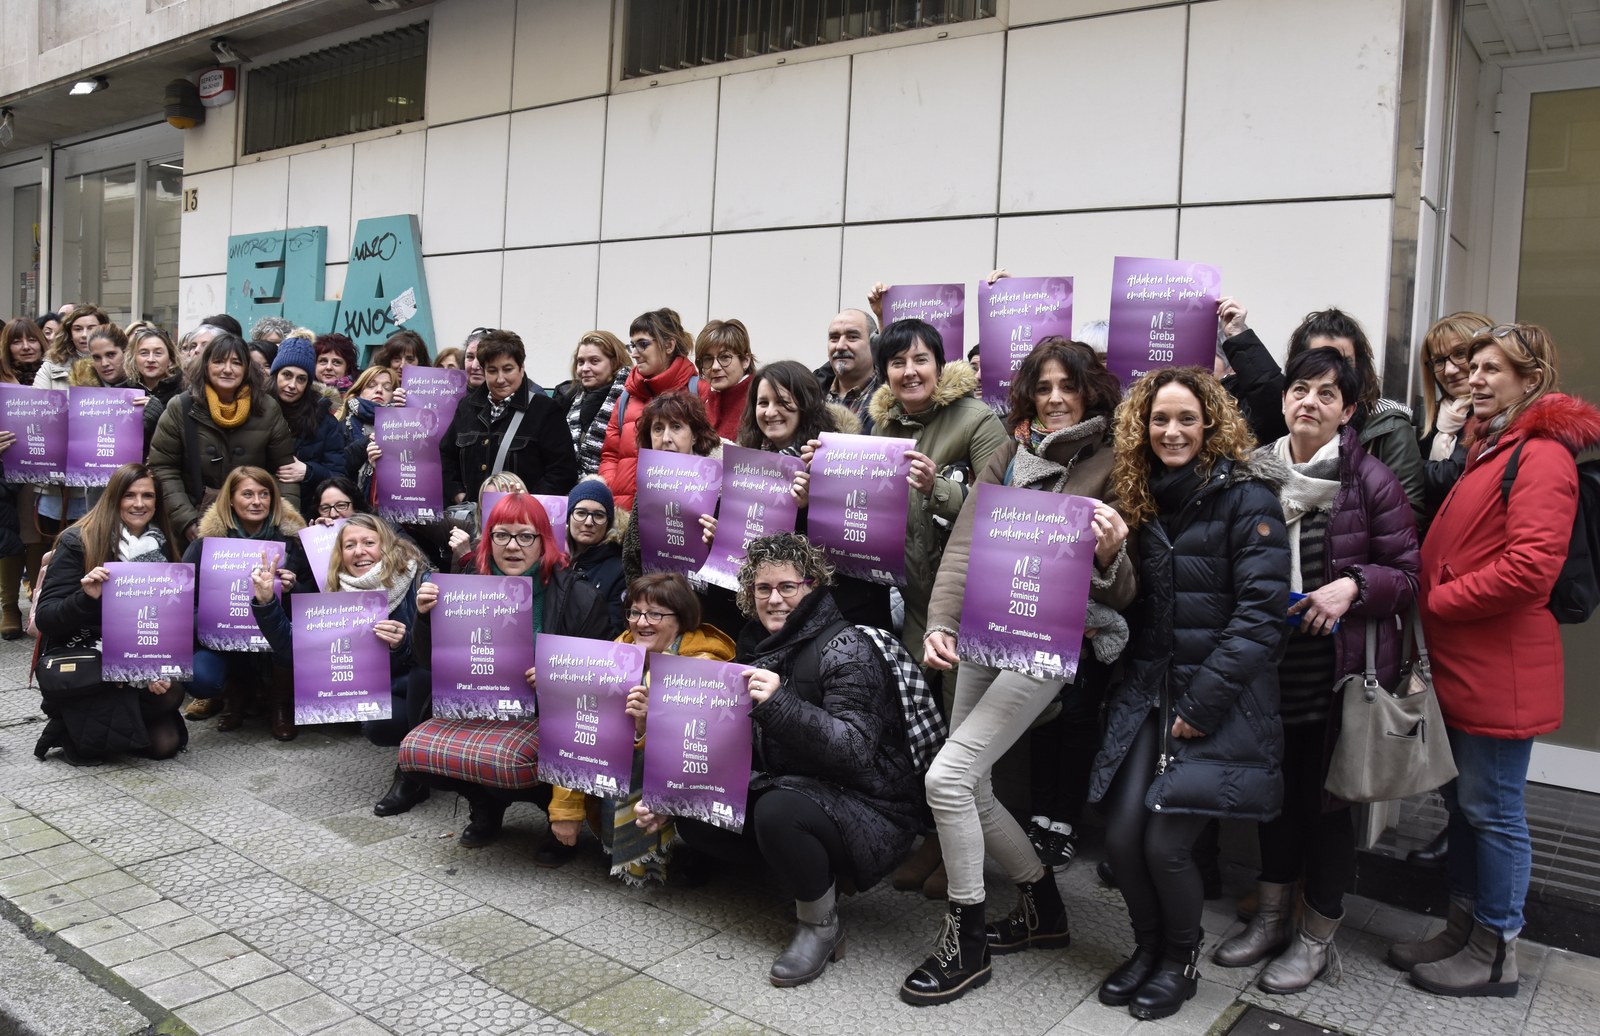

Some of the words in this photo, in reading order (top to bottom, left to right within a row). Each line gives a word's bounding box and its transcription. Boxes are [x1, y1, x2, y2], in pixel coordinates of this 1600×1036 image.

[184, 190, 198, 212] 13
[1127, 273, 1162, 286] Aldaketa
[226, 213, 437, 368] ELA
[1150, 330, 1174, 341] Greba
[1148, 350, 1173, 361] 2019
[29, 447, 45, 455] 2019
[826, 449, 858, 463] Aldaketa
[845, 510, 868, 521] Greba
[991, 507, 1031, 525] Aldaketa
[666, 517, 683, 528] Greba
[746, 520, 763, 532] Greba
[844, 520, 867, 529] Feminista
[667, 534, 684, 546] 2019
[844, 530, 866, 542] 2019
[871, 569, 894, 580] ELA
[1012, 578, 1040, 592] Greba
[444, 590, 477, 604] Aldaketa
[1010, 591, 1038, 602] Feminista
[230, 608, 248, 616] 2019
[305, 606, 337, 619] Aldaketa
[1009, 602, 1036, 618] 2019
[138, 636, 158, 645] 2019
[1039, 632, 1051, 641] todo
[471, 645, 494, 655] Greba
[549, 654, 583, 668] Aldaketa
[1034, 650, 1061, 666] ELA
[471, 664, 493, 675] 2019
[332, 671, 353, 681] 2019
[663, 675, 697, 689] Aldaketa
[358, 702, 379, 711] ELA
[499, 700, 521, 709] ELA
[576, 711, 598, 724] Greba
[575, 723, 597, 733] Feminista
[574, 731, 596, 746] 2019
[684, 740, 707, 753] Greba
[682, 751, 708, 761] Feminista
[683, 762, 708, 774] 2019
[596, 775, 617, 788] ELA
[713, 802, 733, 817] ELA
